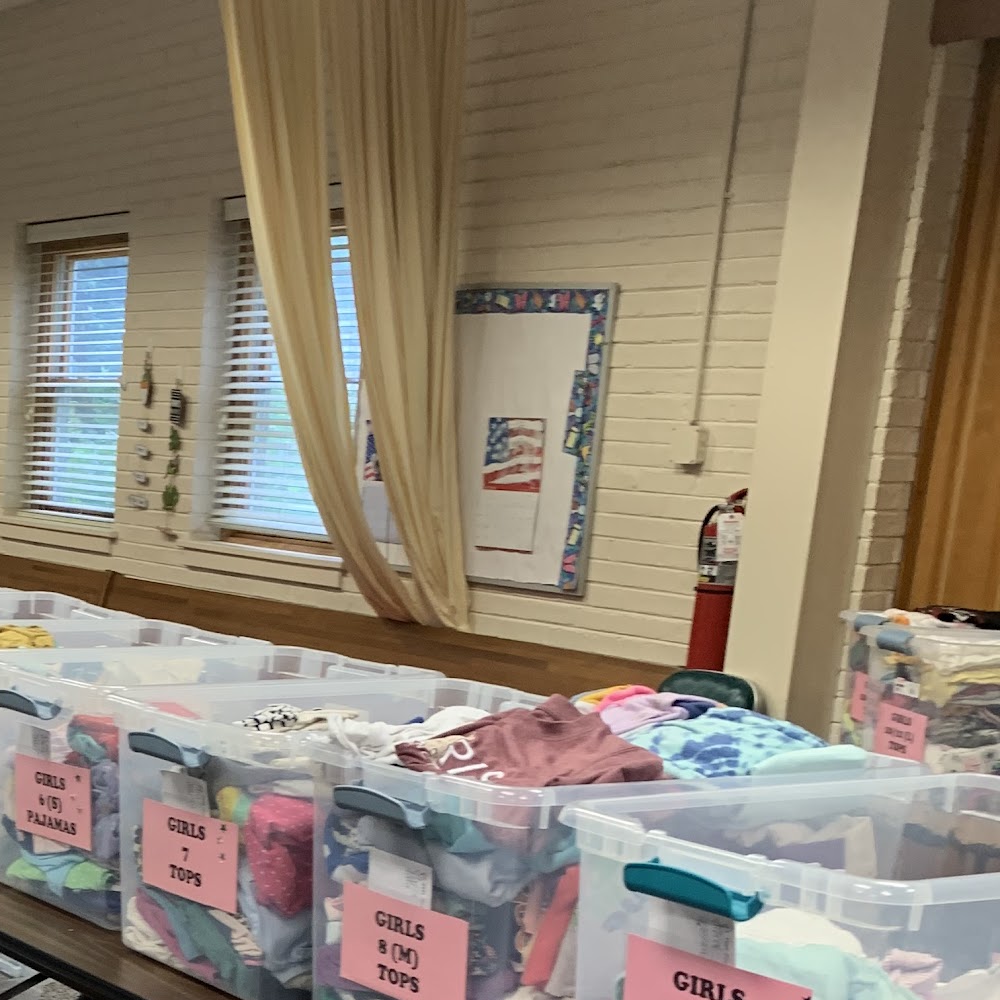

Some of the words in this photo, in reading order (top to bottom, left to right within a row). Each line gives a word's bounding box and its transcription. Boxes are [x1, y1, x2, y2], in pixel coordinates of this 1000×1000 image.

[35, 771, 66, 790] GIRLS
[39, 793, 46, 806] 6
[47, 795, 63, 813] (S)
[26, 809, 77, 835] PAJAMAS
[167, 816, 206, 840] GIRLS
[181, 846, 190, 862] 7
[169, 864, 202, 887] TOPS
[375, 910, 425, 941] GIRLS
[378, 939, 387, 954] 8
[391, 943, 419, 970] (M)
[377, 963, 420, 993] TOPS
